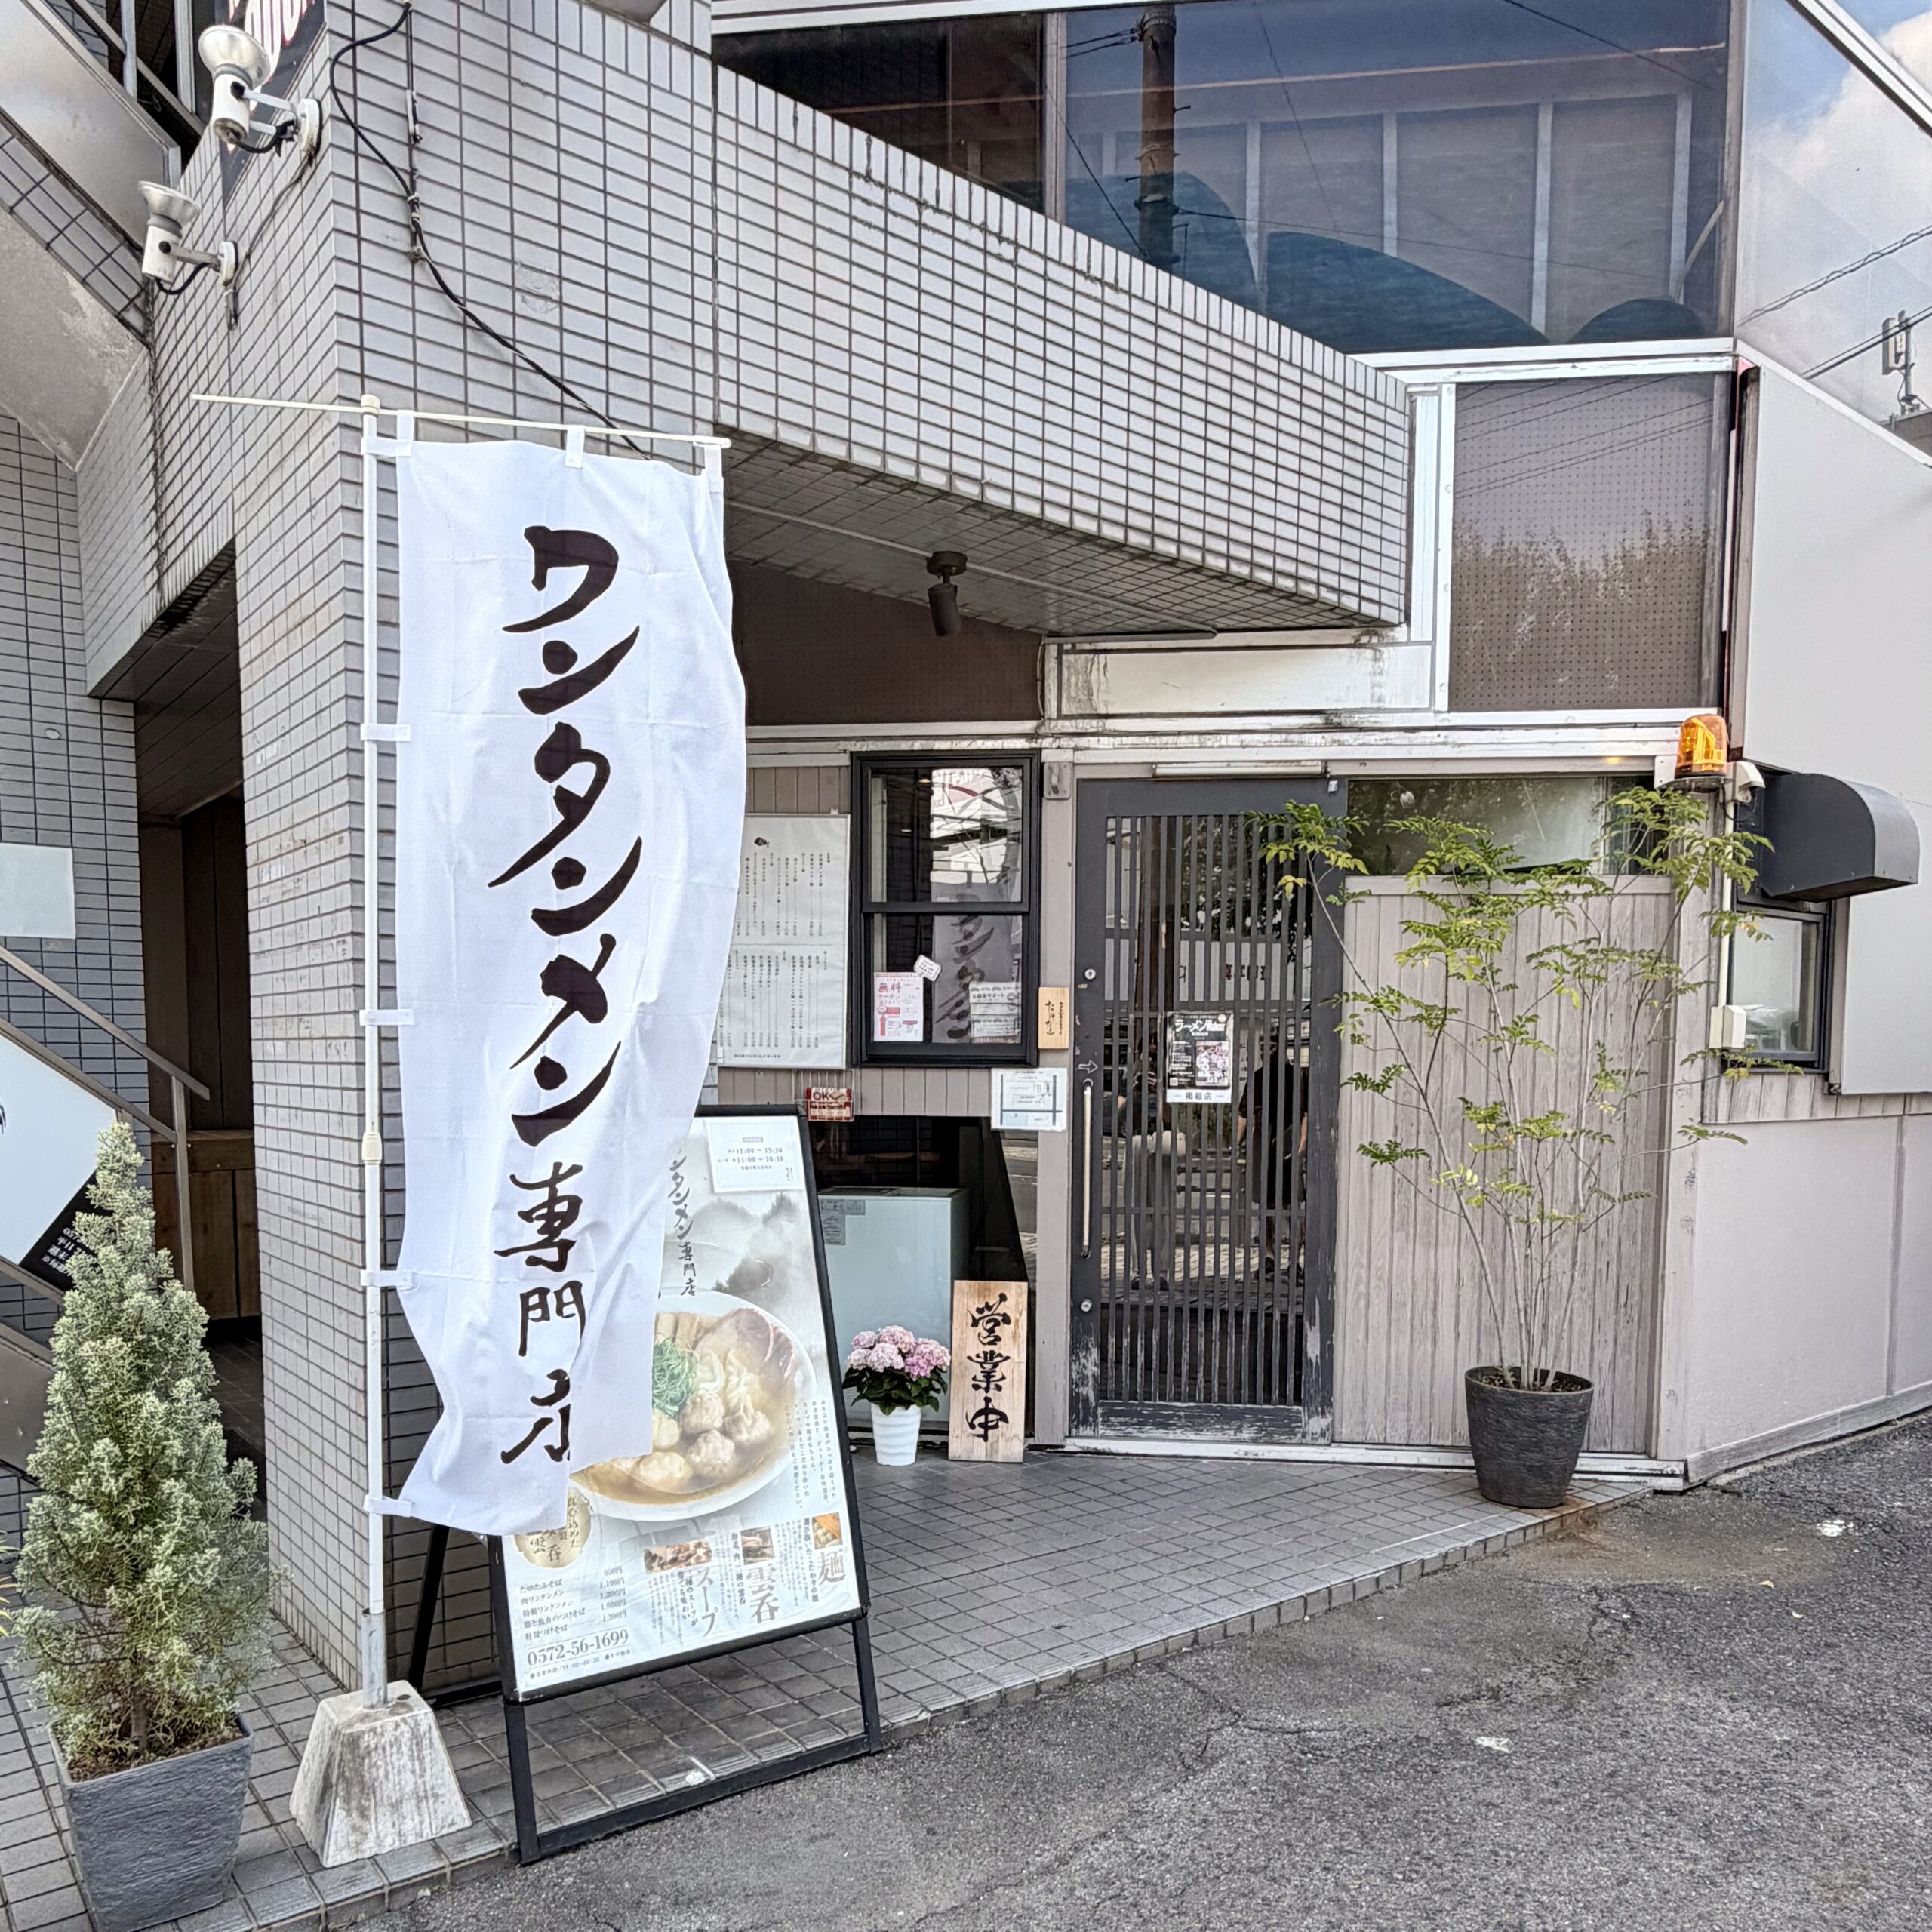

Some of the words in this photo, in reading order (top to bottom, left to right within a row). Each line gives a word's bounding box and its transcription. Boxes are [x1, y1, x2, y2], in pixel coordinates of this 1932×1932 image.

[667, 1149, 697, 1297] ンタンメン専門店
[966, 1292, 1011, 1443] 営業中
[695, 1566, 718, 1637] スープ
[746, 1563, 780, 1624] 雲呑
[527, 1629, 629, 1666] 0572-56-1699
